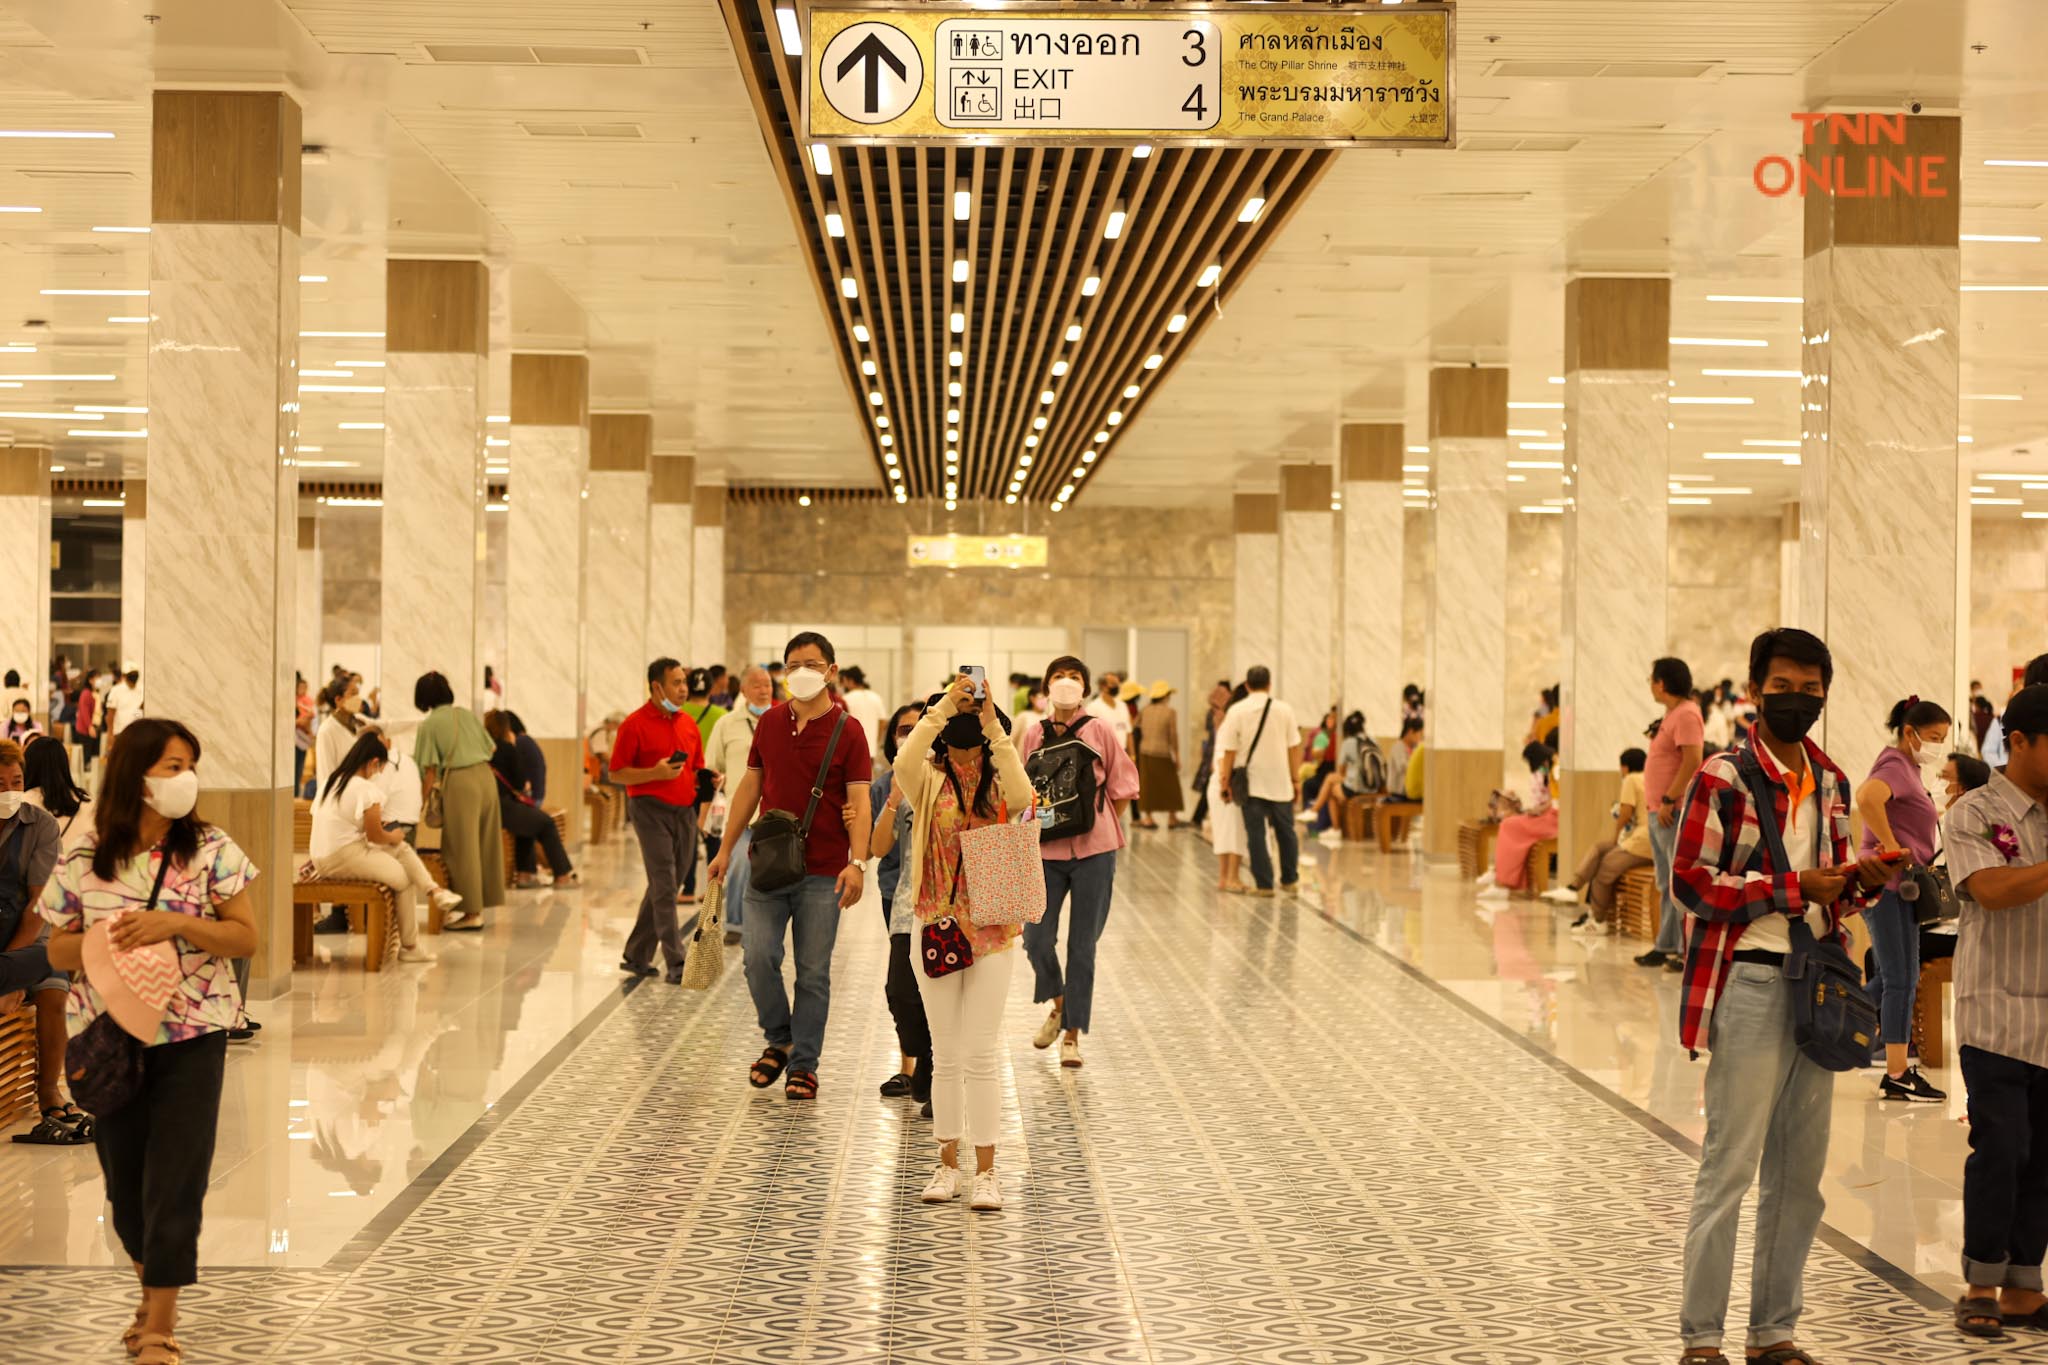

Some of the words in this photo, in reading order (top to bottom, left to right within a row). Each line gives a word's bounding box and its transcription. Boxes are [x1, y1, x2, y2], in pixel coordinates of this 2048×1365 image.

[1010, 33, 1140, 55] ทางออก
[1181, 29, 1207, 67] 3
[1239, 26, 1383, 51] ศาลหลักเมือง
[1239, 60, 1257, 70] The
[1260, 60, 1278, 72] City
[1281, 60, 1304, 70] Pillar
[1308, 60, 1338, 70] Shrine
[1014, 69, 1074, 89] EXIT
[1238, 79, 1440, 102] พระบรมมหาราชวัง
[1014, 96, 1061, 120] 出口
[1181, 83, 1208, 121] 4
[1239, 112, 1256, 122] The
[1259, 112, 1289, 122] Grand
[1292, 112, 1325, 123] Palace
